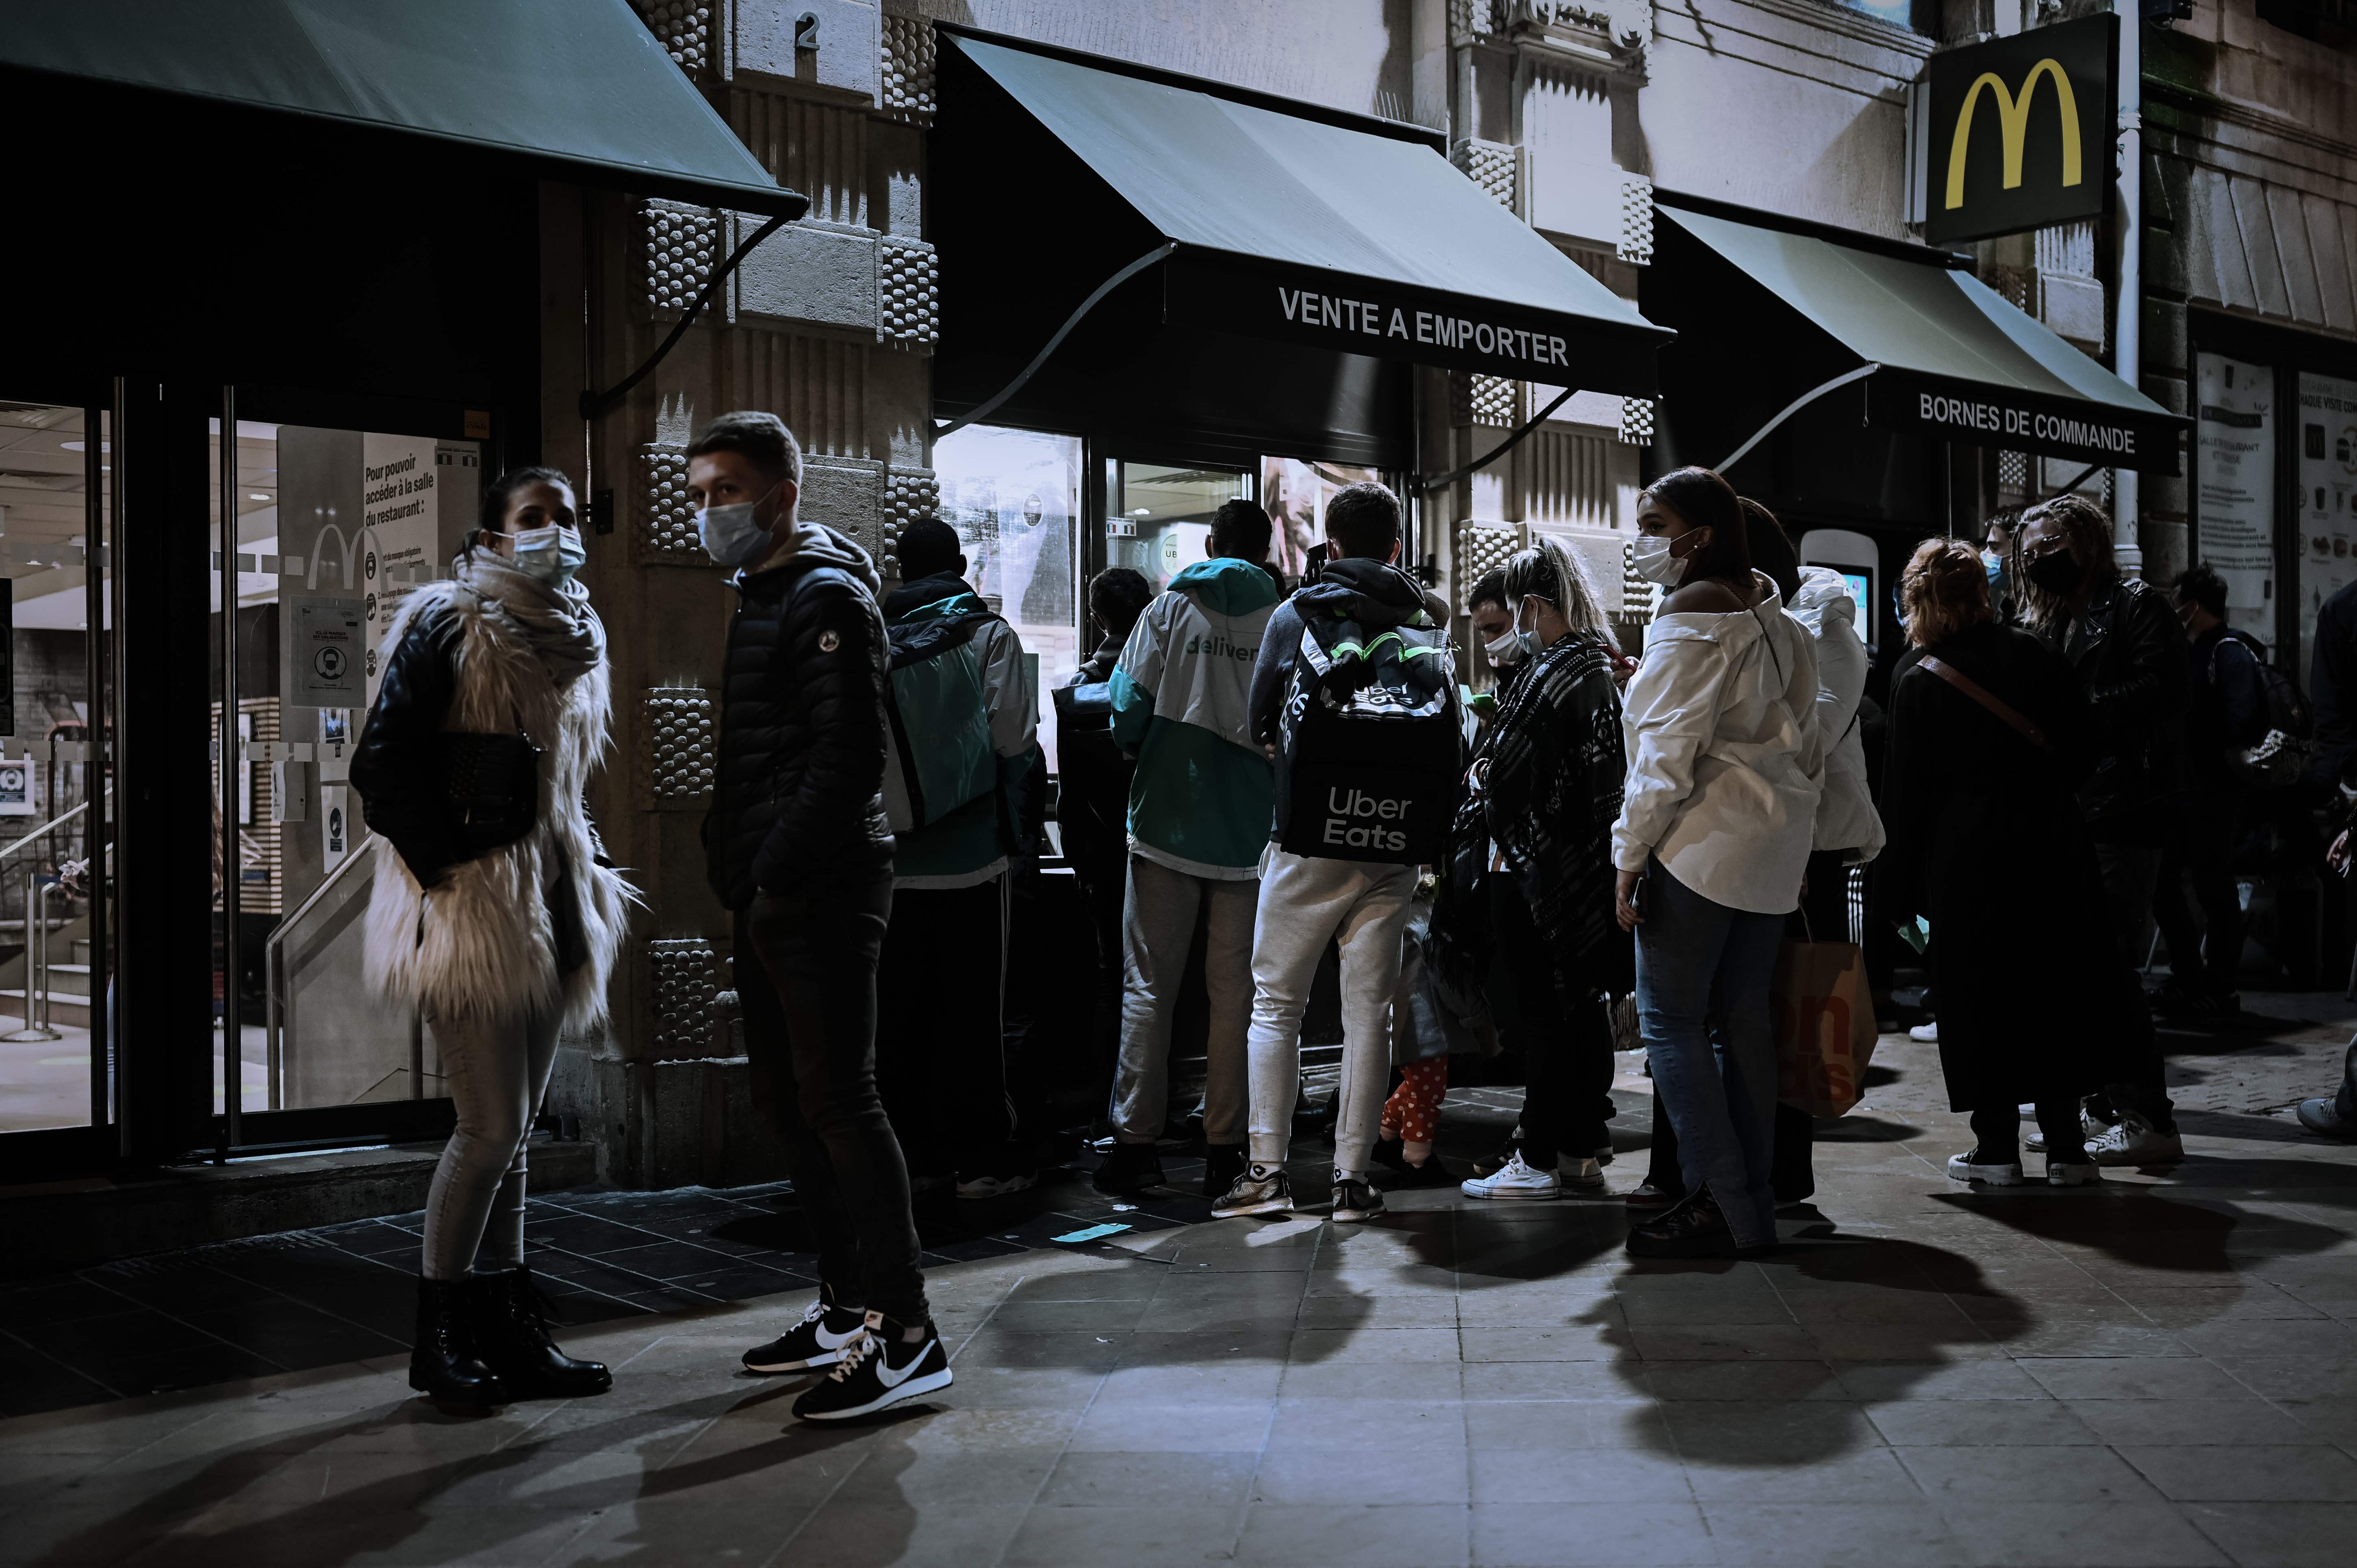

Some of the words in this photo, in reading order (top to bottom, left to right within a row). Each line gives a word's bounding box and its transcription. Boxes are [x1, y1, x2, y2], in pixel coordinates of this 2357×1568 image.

[795, 11, 820, 50] 2
[1278, 287, 1380, 336] VENTE
[1387, 308, 1409, 340] A
[1416, 310, 1569, 367] EMPORTER
[2300, 393, 2322, 408] HAQUE
[2324, 396, 2342, 412] VISITE
[1919, 392, 2000, 432] BORNES
[2005, 409, 2031, 437] DE
[2035, 413, 2136, 455] COMMANDE
[366, 466, 384, 483] Pour
[385, 453, 416, 482] pouvoir
[366, 483, 397, 505] accéder
[399, 478, 404, 496] à
[405, 478, 412, 494] la
[414, 472, 434, 492] salle
[366, 510, 375, 527] du
[377, 499, 420, 525] restaurant
[1185, 633, 1259, 661] deliver
[1328, 787, 1412, 820] Uber
[1323, 818, 1407, 851] Eats
